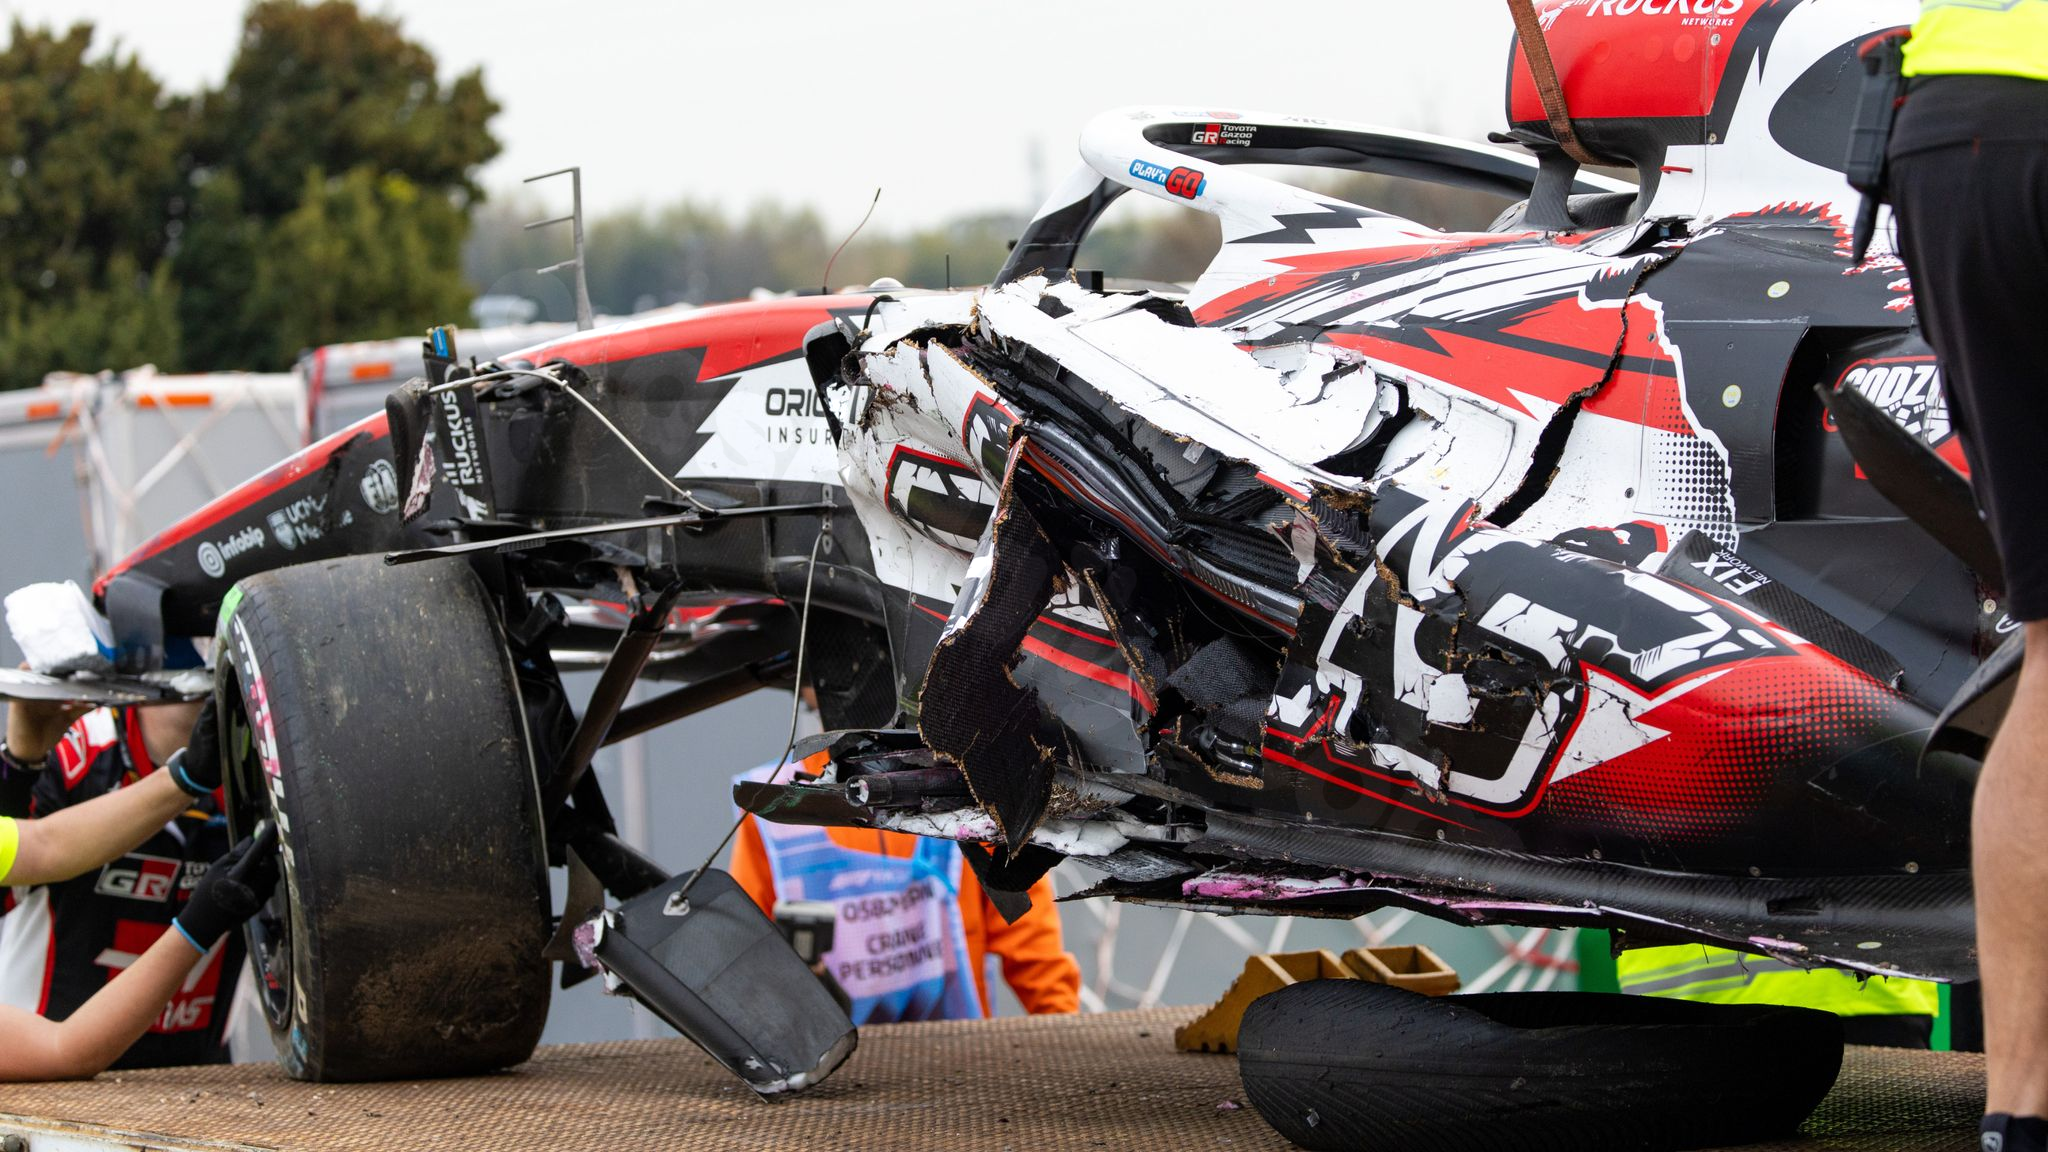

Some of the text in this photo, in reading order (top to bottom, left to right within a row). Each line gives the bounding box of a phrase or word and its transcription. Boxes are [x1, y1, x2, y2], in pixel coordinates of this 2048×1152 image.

[1681, 17, 1734, 27] NETWORKS
[1192, 131, 1218, 144] GR
[1223, 124, 1257, 132] TOYOTA
[1168, 167, 1202, 197] GO
[441, 390, 475, 485] RUCKUS
[463, 416, 484, 484] NETWORKS
[217, 525, 265, 561] infobip
[1690, 553, 1762, 596] FIX
[1715, 549, 1772, 585] NETWORK
[102, 868, 169, 899] GR
